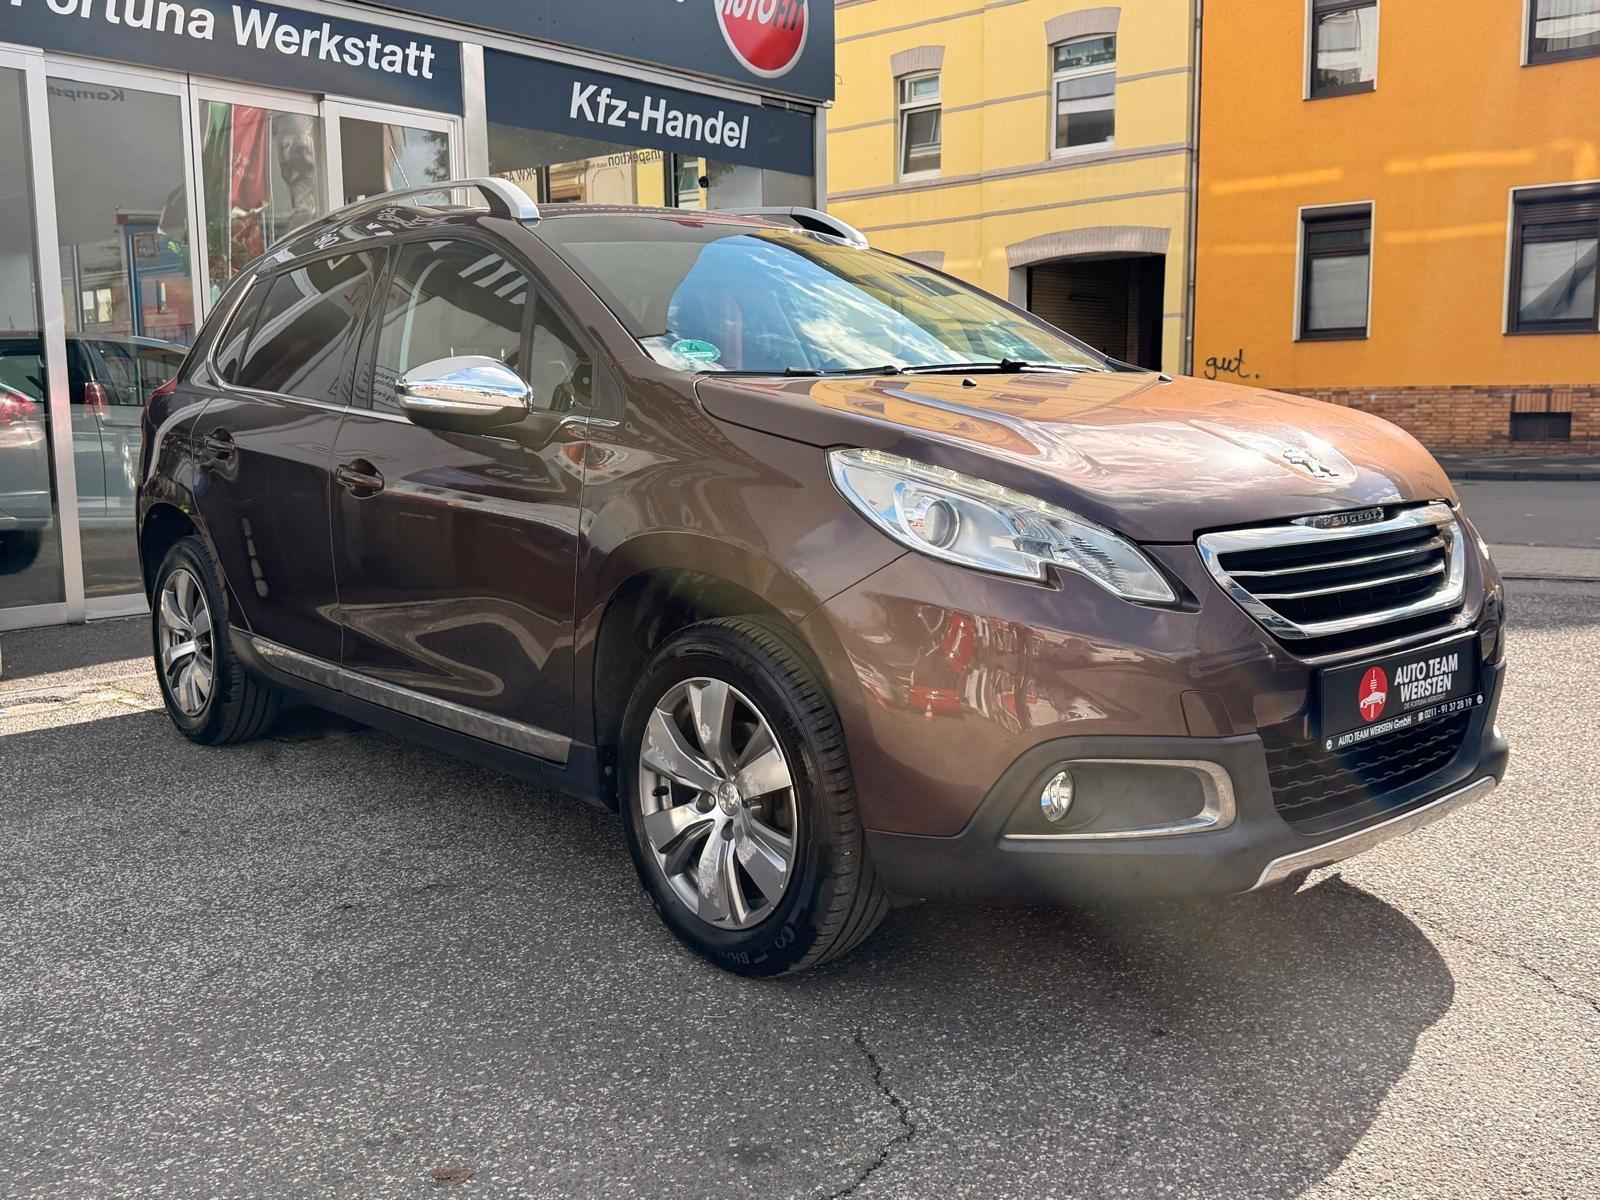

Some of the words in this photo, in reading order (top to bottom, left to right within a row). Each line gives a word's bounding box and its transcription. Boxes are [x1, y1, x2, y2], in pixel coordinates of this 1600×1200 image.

[10, 0, 215, 40] ortuna
[232, 5, 435, 79] Werkstatt
[570, 81, 749, 149] Kfz-Handel
[1324, 511, 1378, 527] PEUGEOT
[1394, 661, 1426, 686] AUTO
[1428, 653, 1458, 677] TEAM
[1400, 673, 1452, 703] WERSTEN
[1424, 707, 1437, 718] 0211
[1441, 703, 1448, 713] 91
[1449, 701, 1456, 711] 37
[1456, 699, 1464, 710] 28
[1465, 698, 1473, 708] 19
[1338, 733, 1354, 747] AUTO
[1354, 729, 1370, 741] TEAM
[1370, 721, 1394, 736] WERSTEN
[1394, 715, 1412, 730] GmbH
